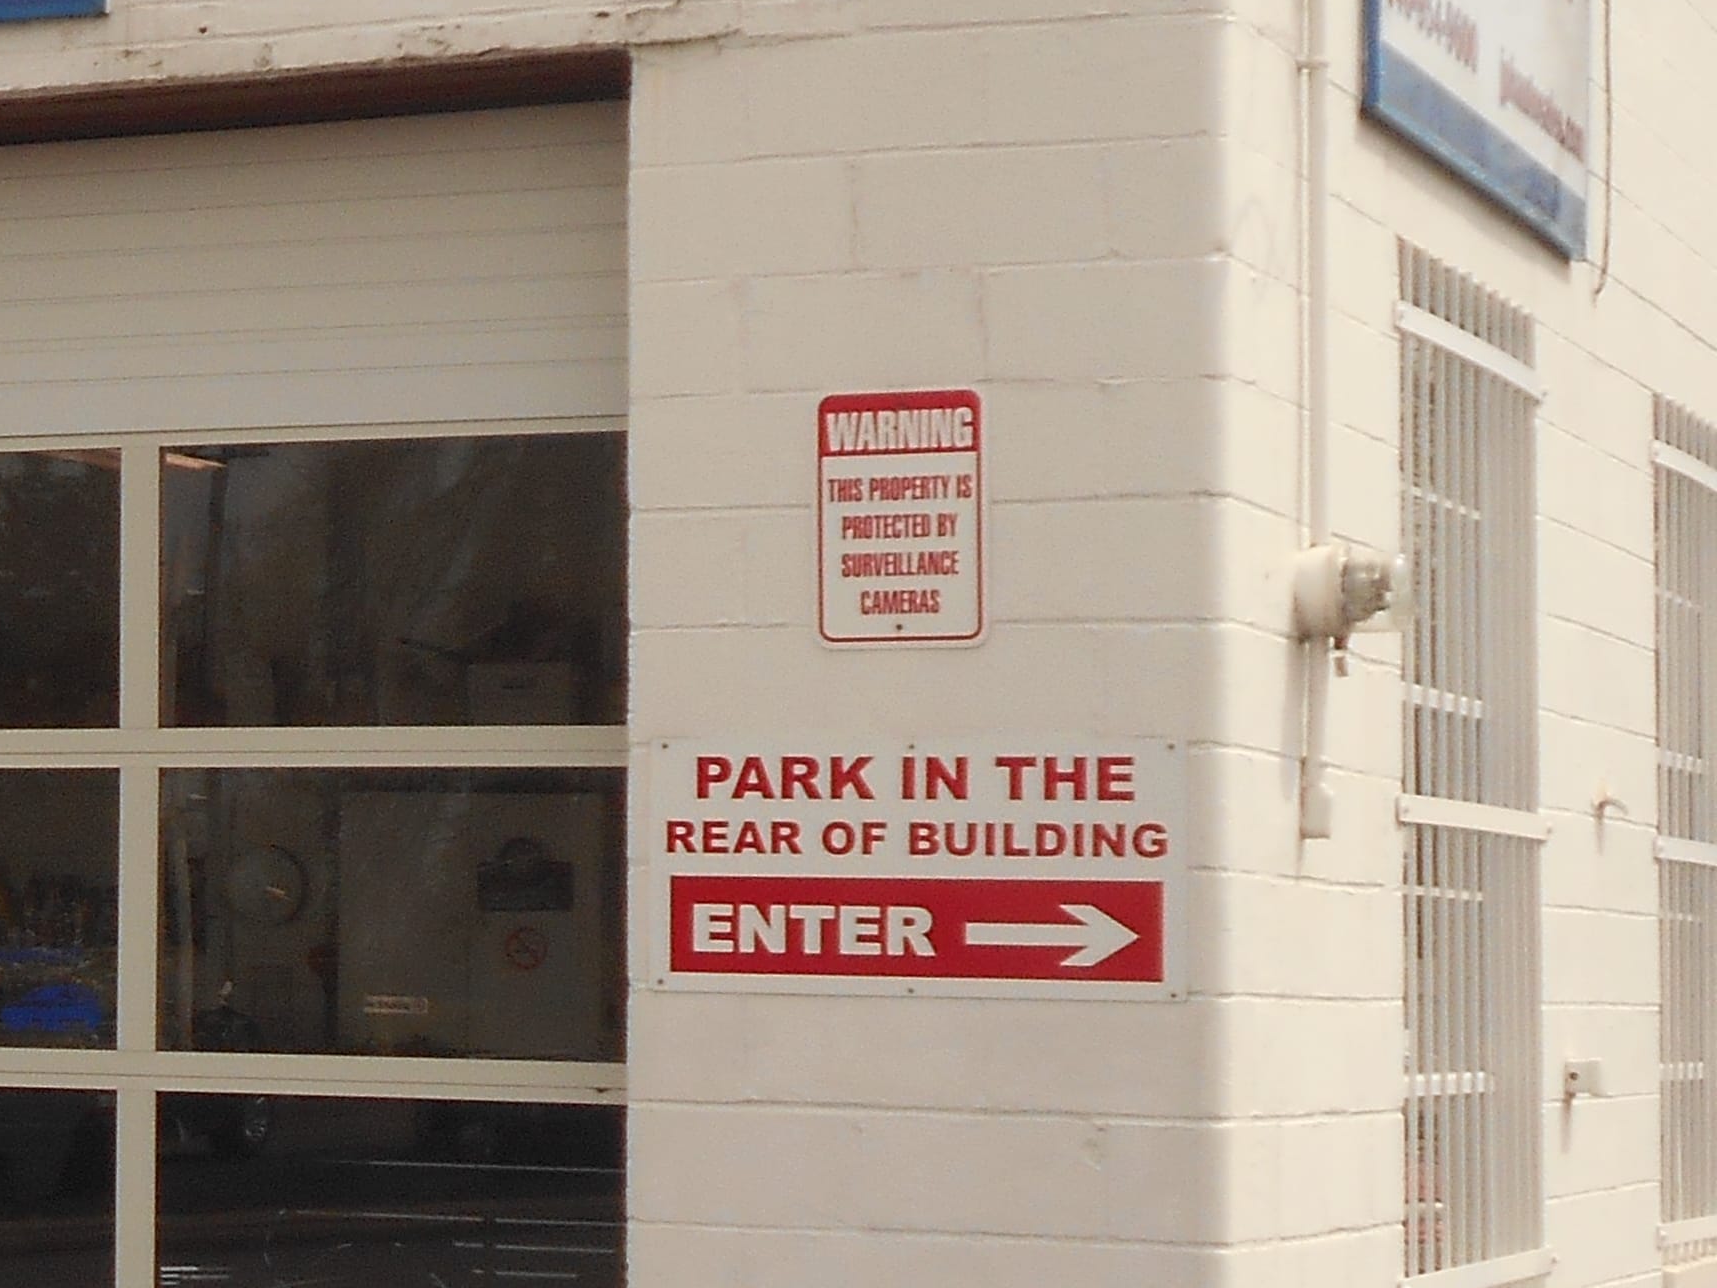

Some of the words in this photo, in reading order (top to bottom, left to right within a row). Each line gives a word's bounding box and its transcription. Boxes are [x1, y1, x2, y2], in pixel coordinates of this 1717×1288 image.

[826, 407, 974, 452] WARNING
[828, 478, 863, 502] THIS
[869, 475, 951, 501] PROPERTY
[956, 474, 972, 498] IS
[841, 514, 931, 540] PROTECTED
[938, 513, 958, 537] BY
[841, 551, 959, 578] SURVEILLANCE
[860, 589, 941, 616] CAMERAS
[695, 755, 875, 800] PARK
[900, 755, 968, 800] IN
[995, 755, 1136, 801] THE
[666, 820, 802, 854] REAR
[821, 820, 888, 856] OF
[907, 821, 1169, 859] BUILDING
[691, 902, 937, 957] ENTER
